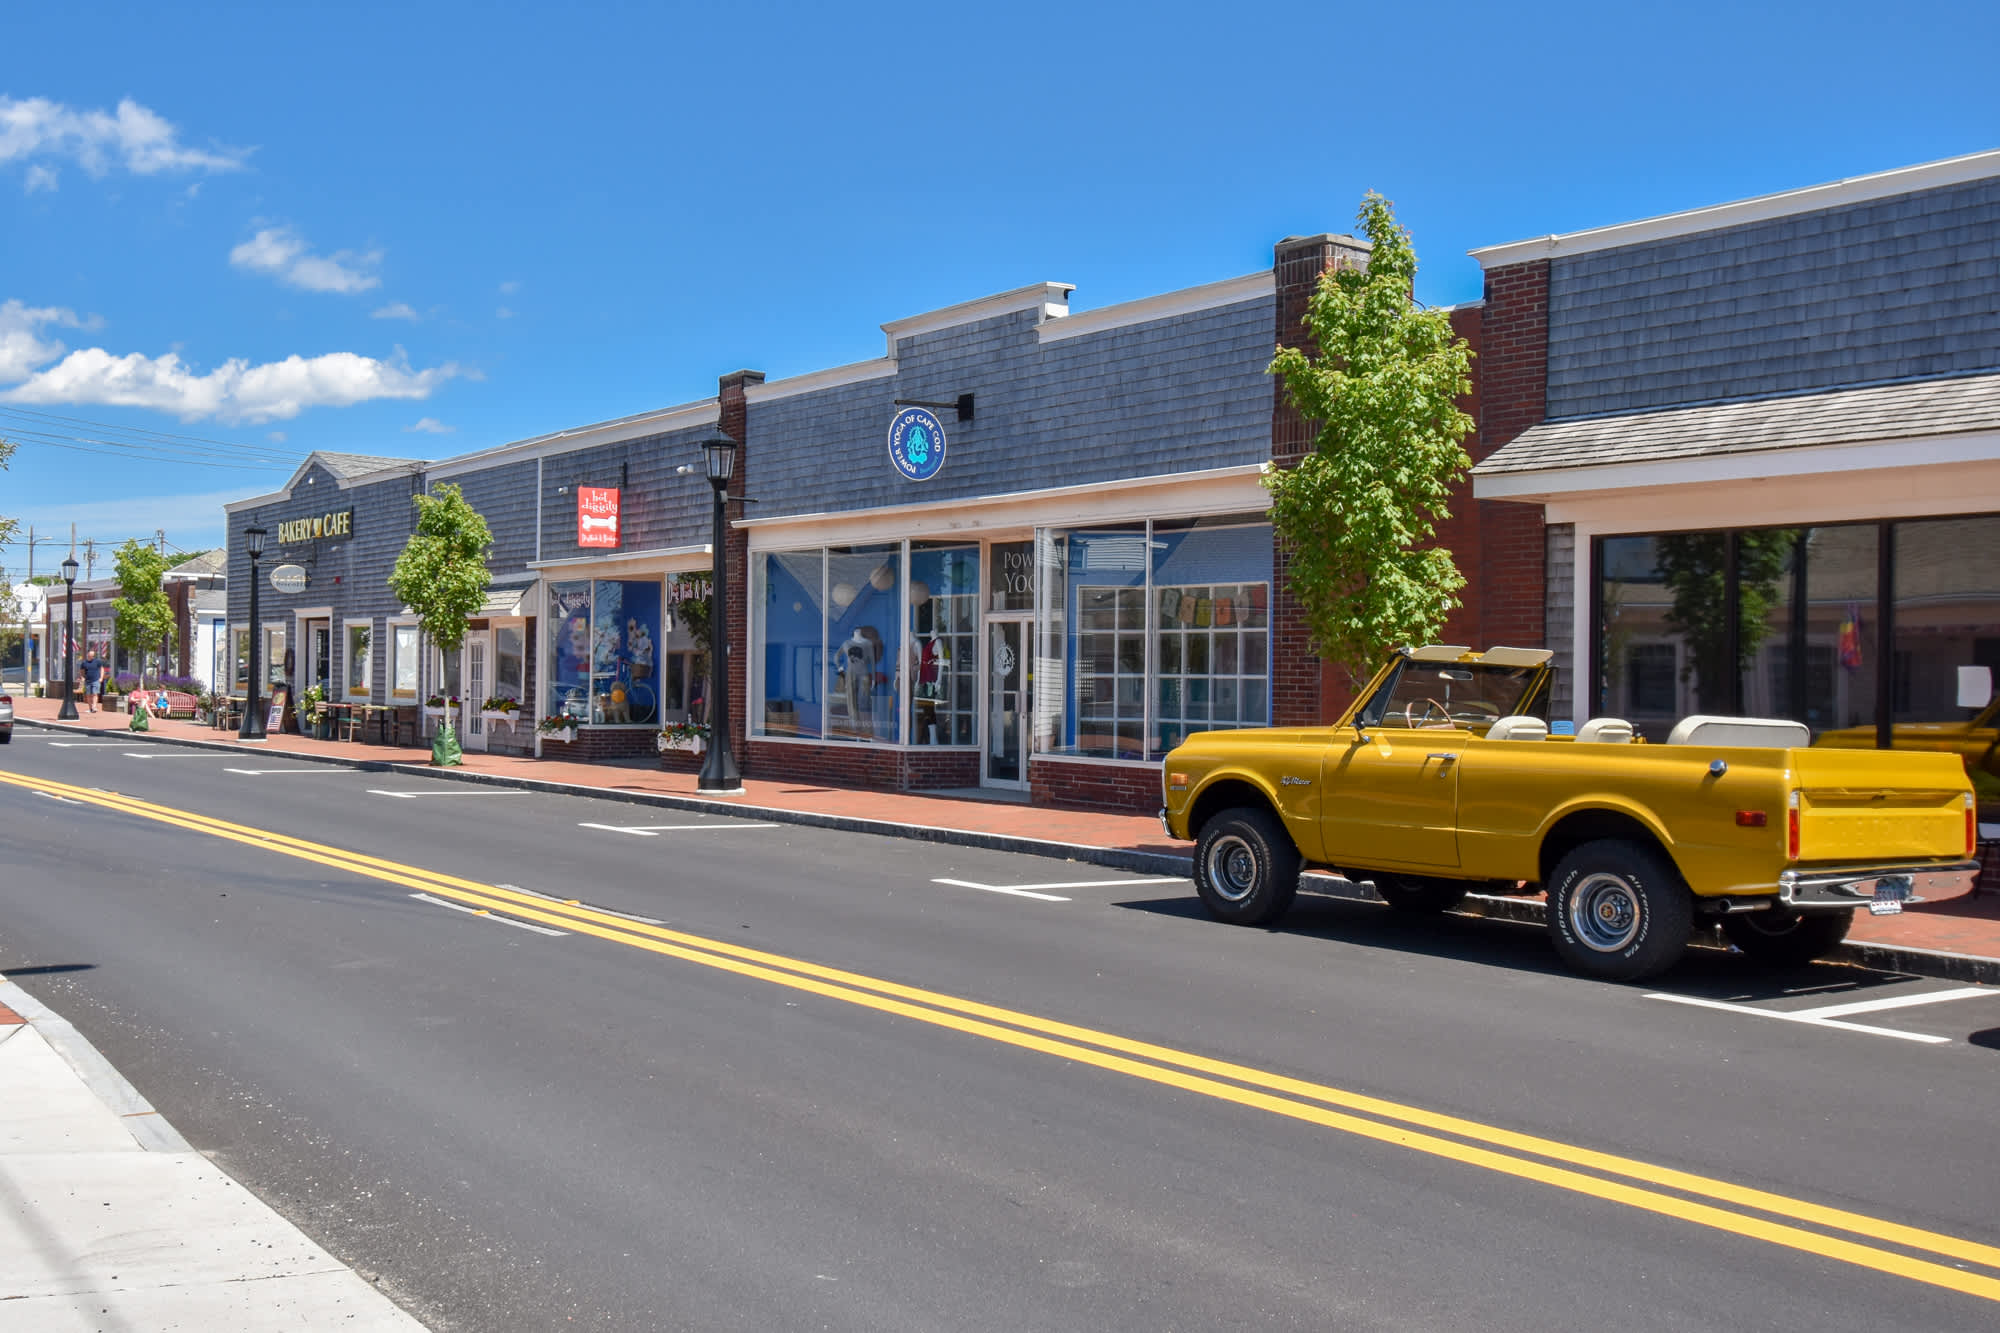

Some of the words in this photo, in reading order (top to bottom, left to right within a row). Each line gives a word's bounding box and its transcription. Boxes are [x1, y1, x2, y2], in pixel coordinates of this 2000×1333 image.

[904, 414, 916, 424] OF
[916, 414, 935, 431] CAPE
[893, 422, 906, 447] YOGA
[932, 430, 941, 453] COD
[894, 447, 917, 474] POWER
[581, 497, 618, 514] diggity
[592, 490, 607, 503] hot
[278, 518, 313, 544] BAKERY
[323, 511, 350, 537] CAFE
